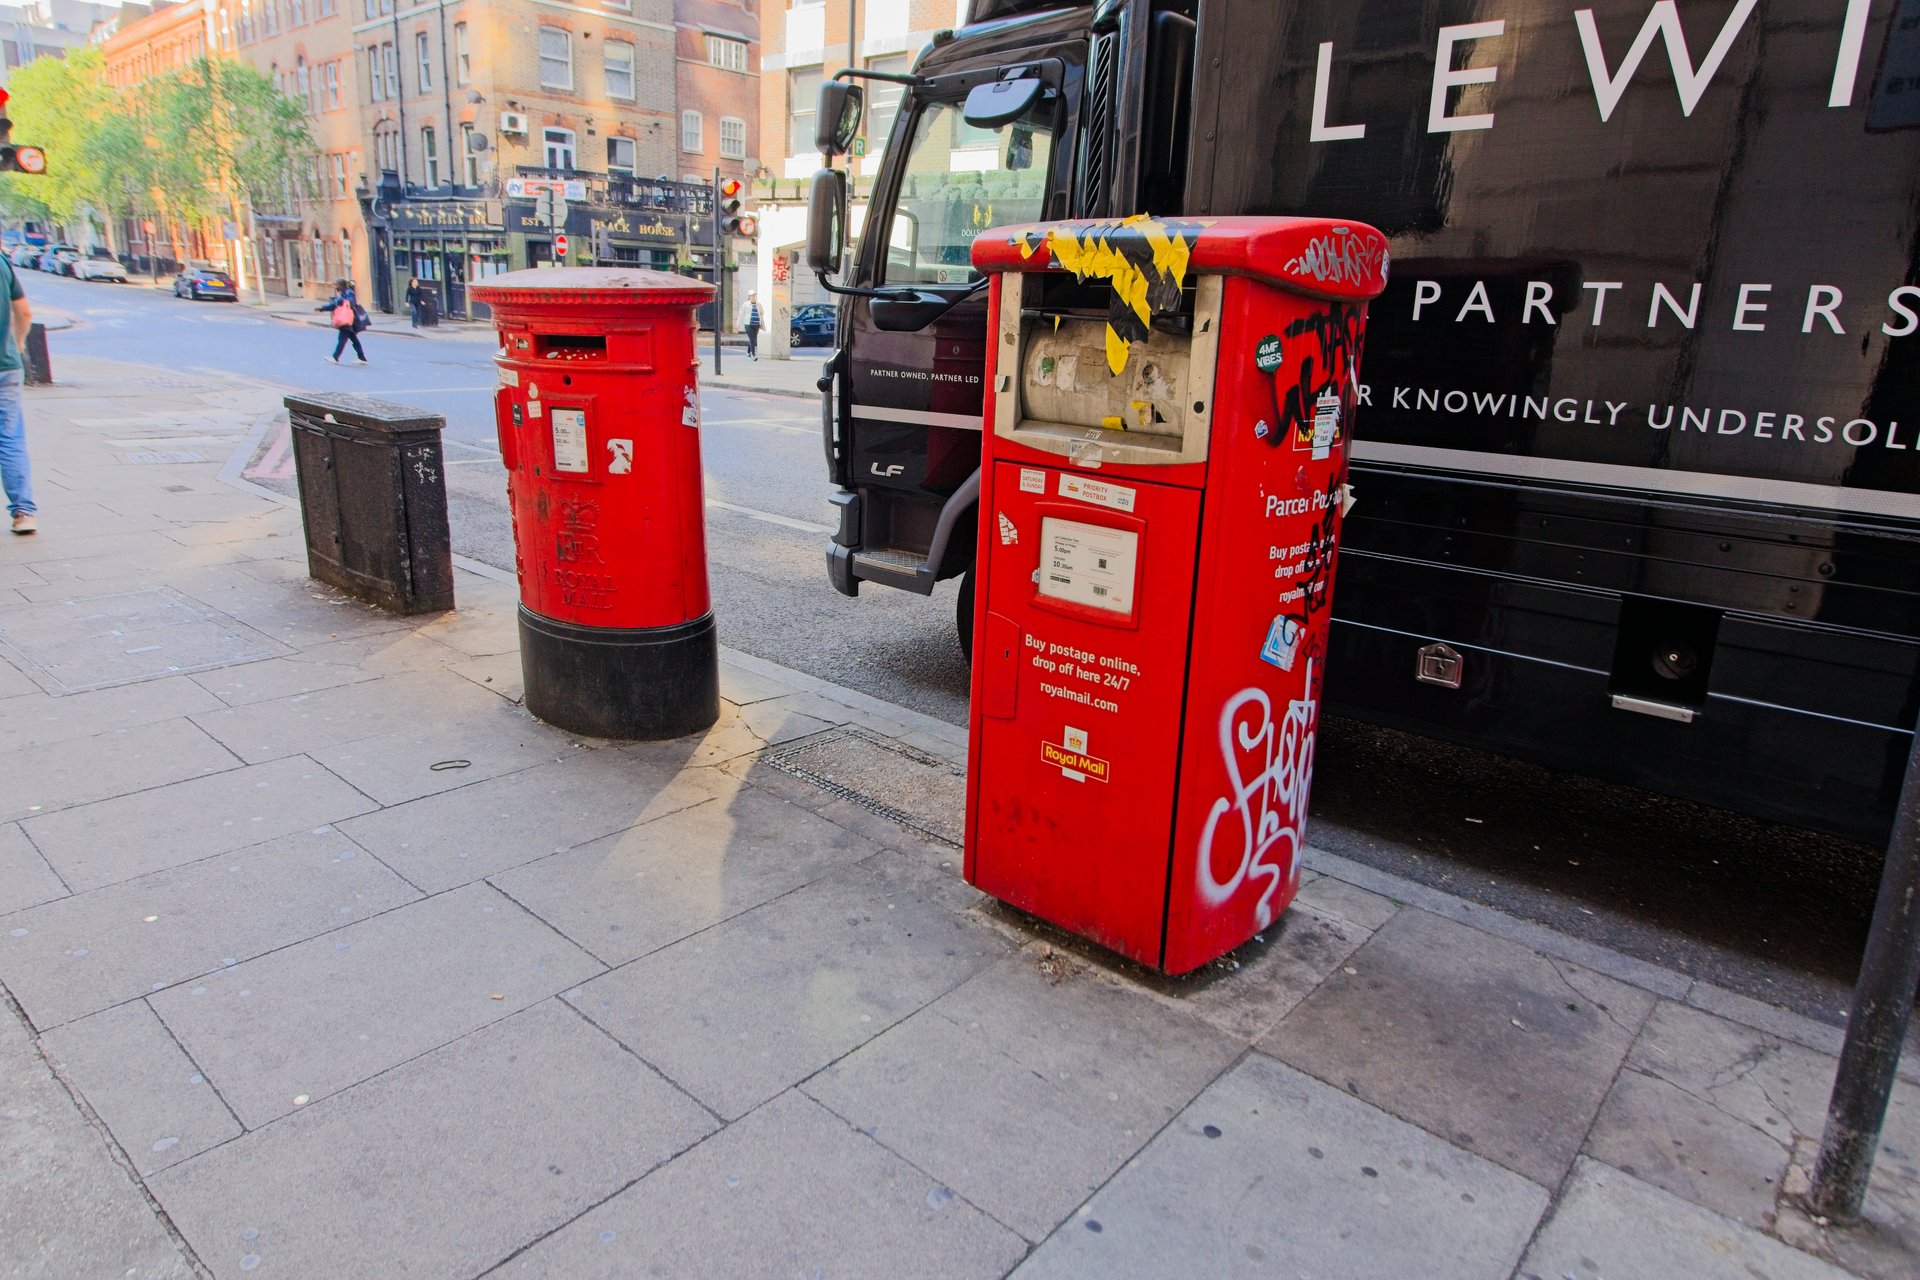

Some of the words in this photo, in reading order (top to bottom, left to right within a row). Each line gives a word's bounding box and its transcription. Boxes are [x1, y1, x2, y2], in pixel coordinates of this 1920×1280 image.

[639, 224, 675, 236] HORSE
[1412, 280, 1920, 337] PARTNERS
[1256, 352, 1283, 367] VIBES
[870, 369, 899, 378] PARTNER
[900, 371, 929, 380] OWNED,
[930, 373, 963, 382] PARTNER
[965, 376, 979, 384] LED
[1392, 386, 1628, 426] KNOWINGLY
[1647, 403, 1920, 450] UNDERSOL
[870, 462, 905, 477] LF
[1026, 482, 1043, 490] SUNDAY
[1083, 482, 1109, 494] PRIORITY
[1082, 490, 1108, 502] POSTBOX
[1269, 545, 1288, 561] Buy
[1274, 565, 1294, 579] drop
[1025, 633, 1047, 652] Buy
[1050, 642, 1096, 664] postage
[1100, 655, 1141, 677] online,
[1032, 655, 1056, 673] drop
[1058, 662, 1075, 676] off
[1076, 666, 1101, 684] here
[1103, 672, 1130, 691] 24/7
[1040, 681, 1119, 713] royalmail.com
[1045, 745, 1077, 767] Royal
[1078, 755, 1105, 776] Mail
